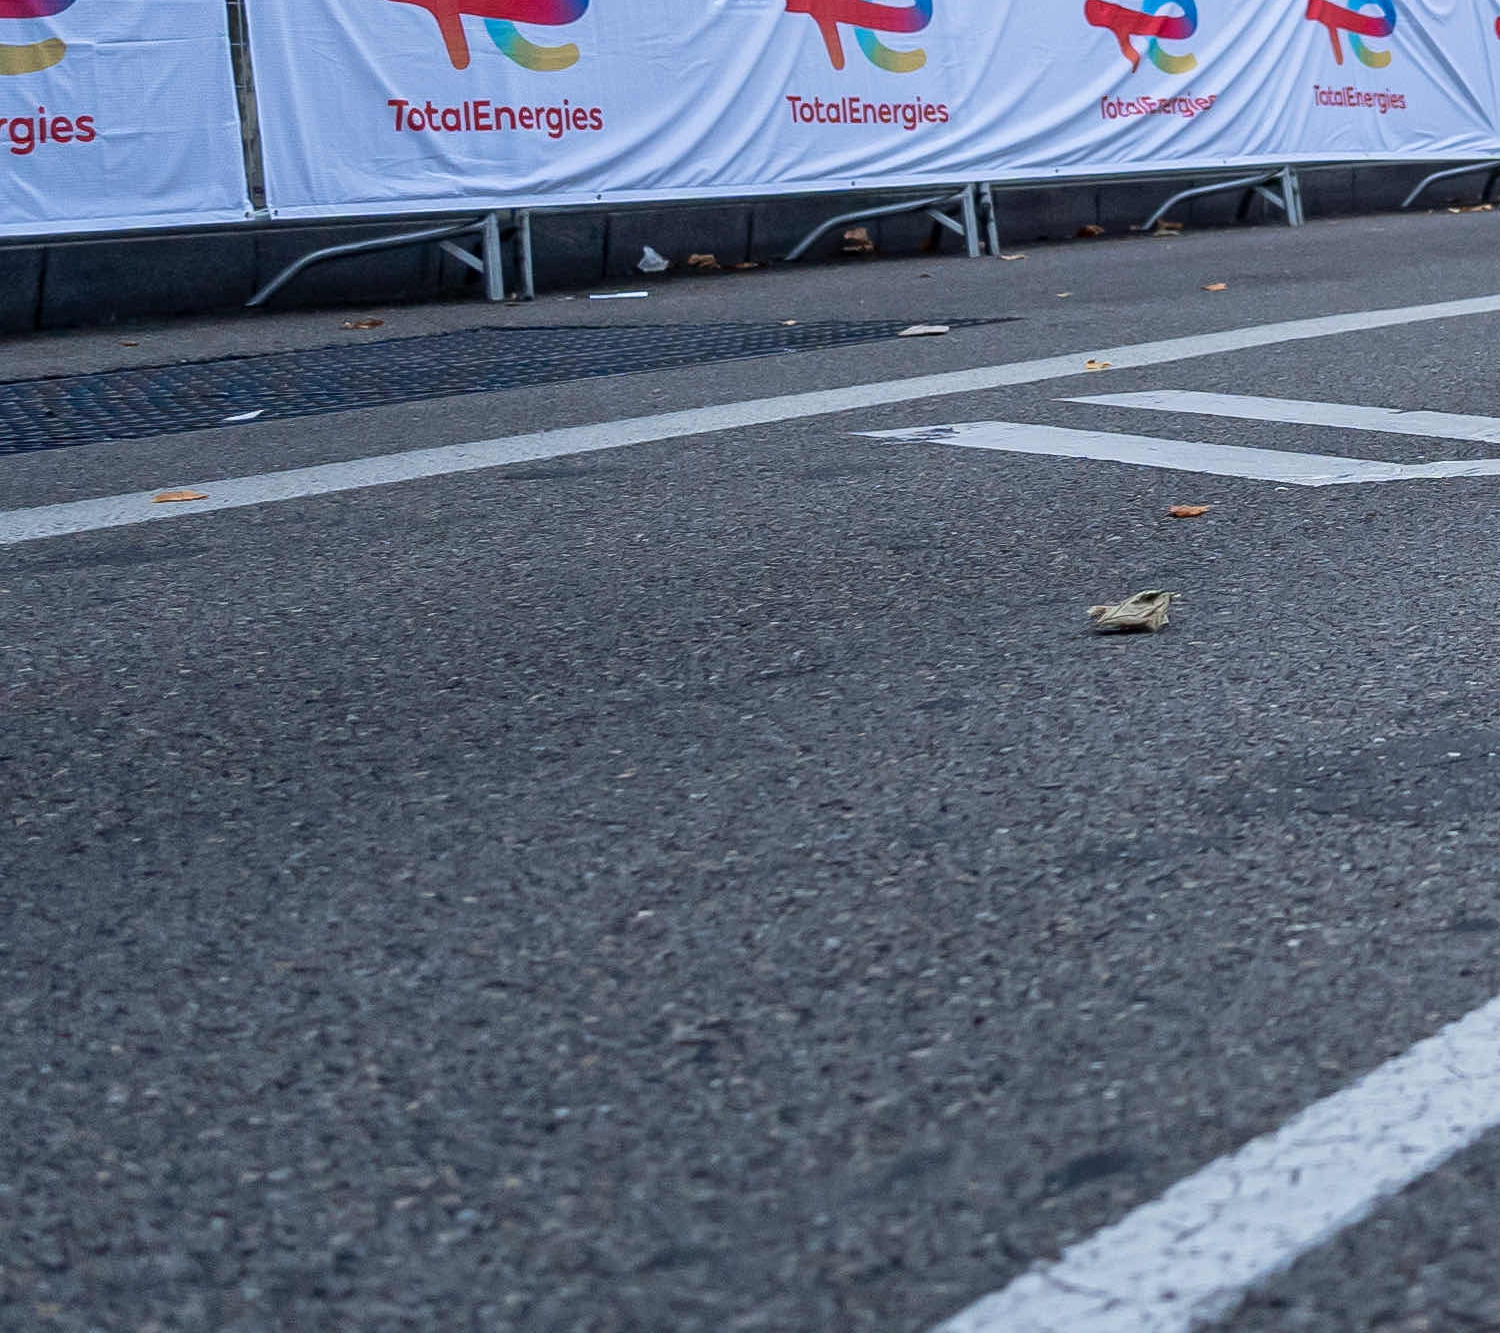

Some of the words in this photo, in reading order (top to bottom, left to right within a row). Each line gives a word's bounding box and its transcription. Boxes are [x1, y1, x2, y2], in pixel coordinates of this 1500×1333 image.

[786, 95, 949, 131] TotalEnergies
[1314, 84, 1407, 114] TotalEnergies
[388, 99, 603, 139] TotalEnergies
